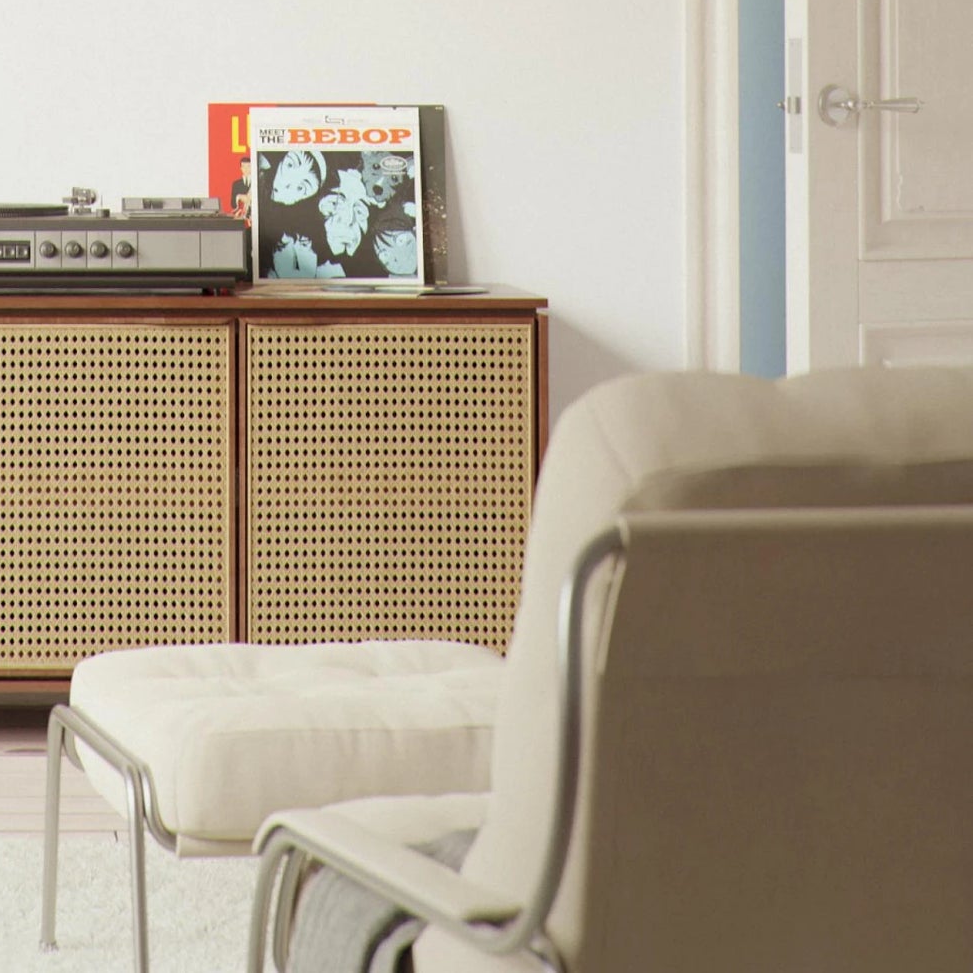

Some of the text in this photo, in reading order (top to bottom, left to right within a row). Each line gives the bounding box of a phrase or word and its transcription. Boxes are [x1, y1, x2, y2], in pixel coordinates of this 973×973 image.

[231, 116, 250, 153] L
[259, 136, 284, 144] THE
[288, 129, 411, 144] BEBOP
